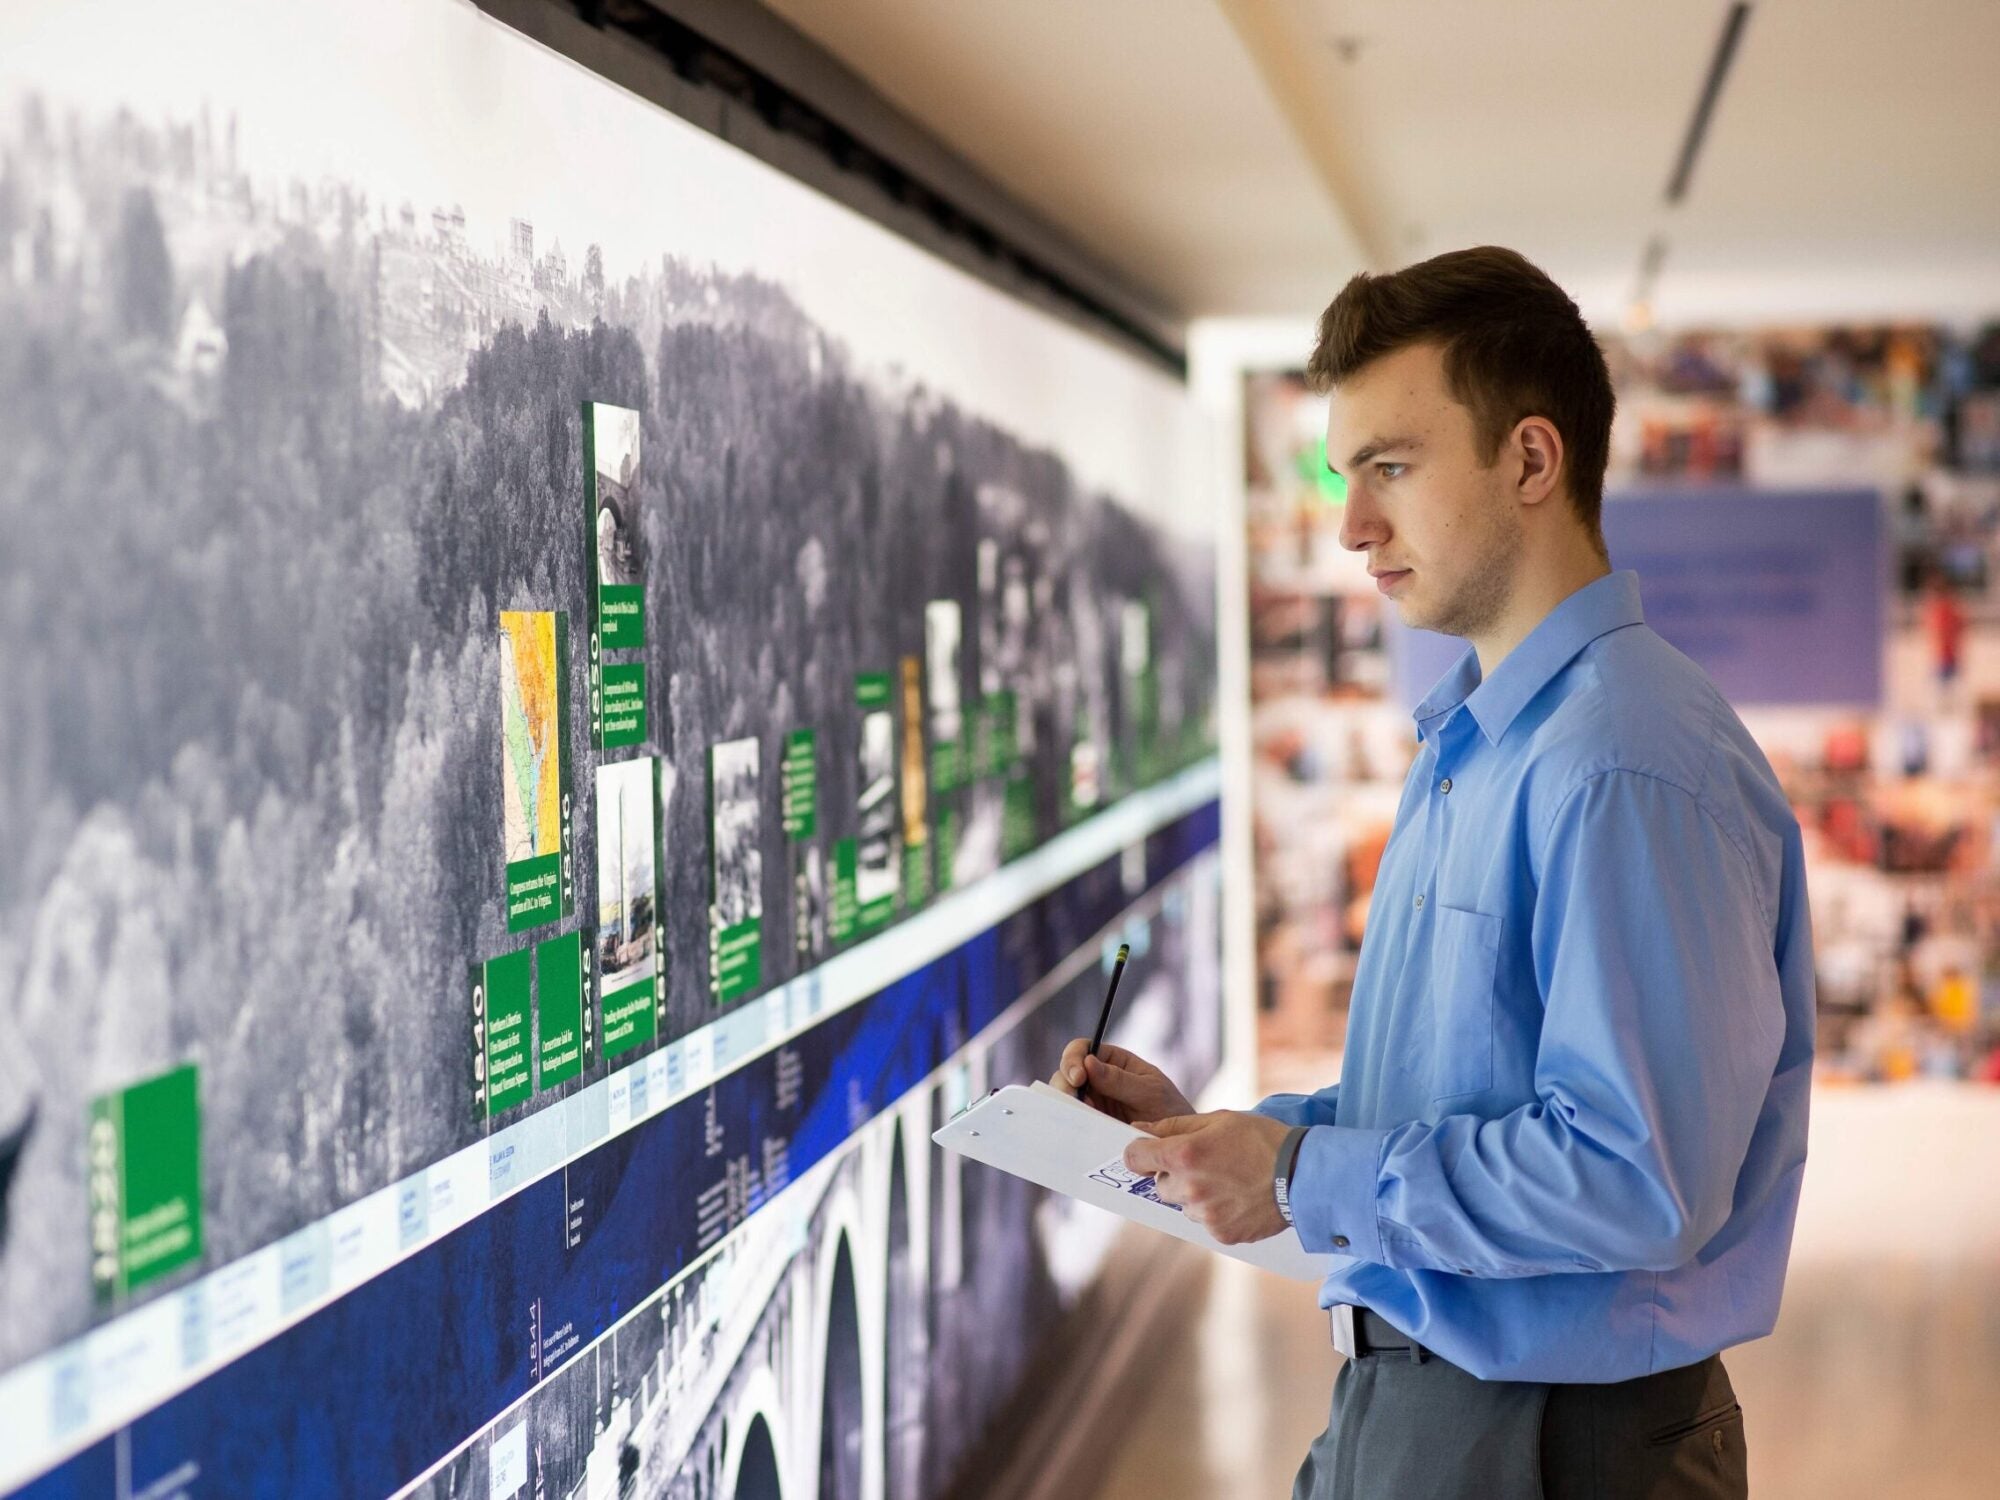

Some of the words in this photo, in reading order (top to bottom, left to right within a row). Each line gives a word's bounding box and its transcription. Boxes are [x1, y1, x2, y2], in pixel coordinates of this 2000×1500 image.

[590, 633, 600, 734] 1850
[543, 871, 556, 888] Virginia
[562, 793, 572, 901] 1846
[472, 985, 485, 1104] 1840
[583, 948, 592, 1054] 1848
[542, 1056, 561, 1073] Washington
[561, 1046, 578, 1064] Monument
[1275, 1177, 1290, 1204] DRUG
[530, 1302, 538, 1377] 1844
